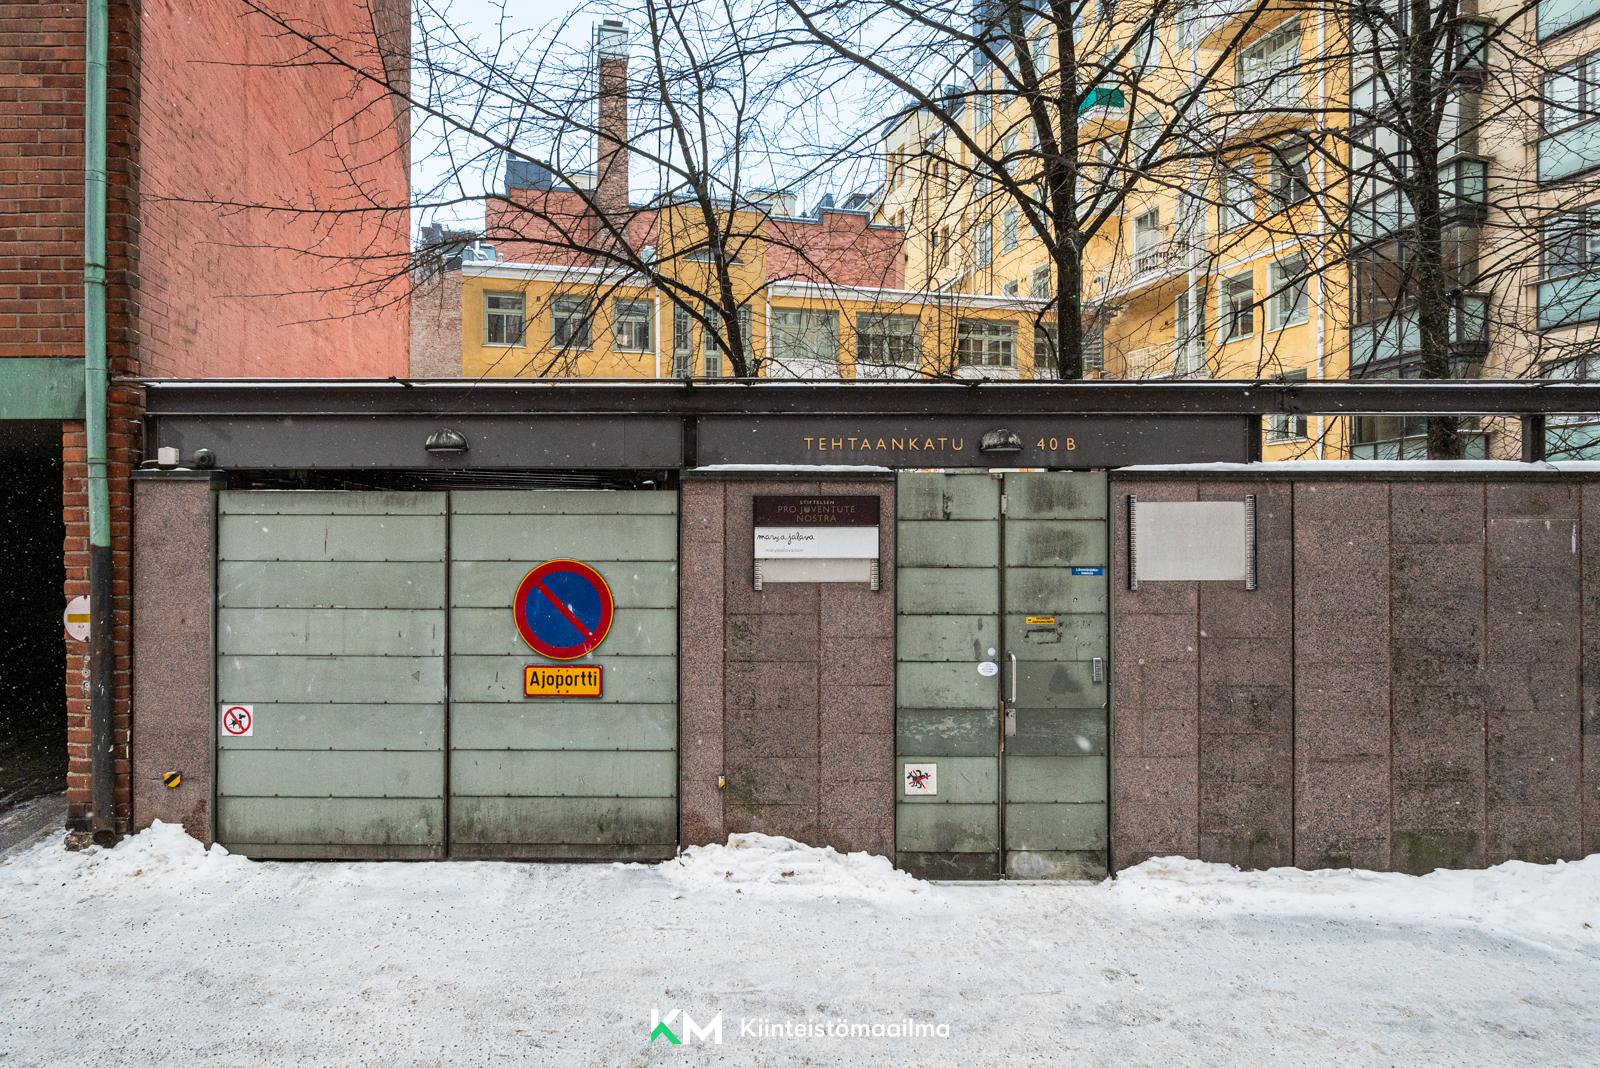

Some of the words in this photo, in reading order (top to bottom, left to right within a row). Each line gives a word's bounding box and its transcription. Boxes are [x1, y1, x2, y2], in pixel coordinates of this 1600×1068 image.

[803, 437, 965, 451] TEHTAANKATU
[1037, 437, 1058, 451] 40
[1066, 437, 1076, 451] B
[777, 505, 797, 513] PRO
[800, 506, 855, 514] JUVENTUTE
[796, 514, 837, 522] NOSTRA
[529, 671, 597, 689] Ajoportti
